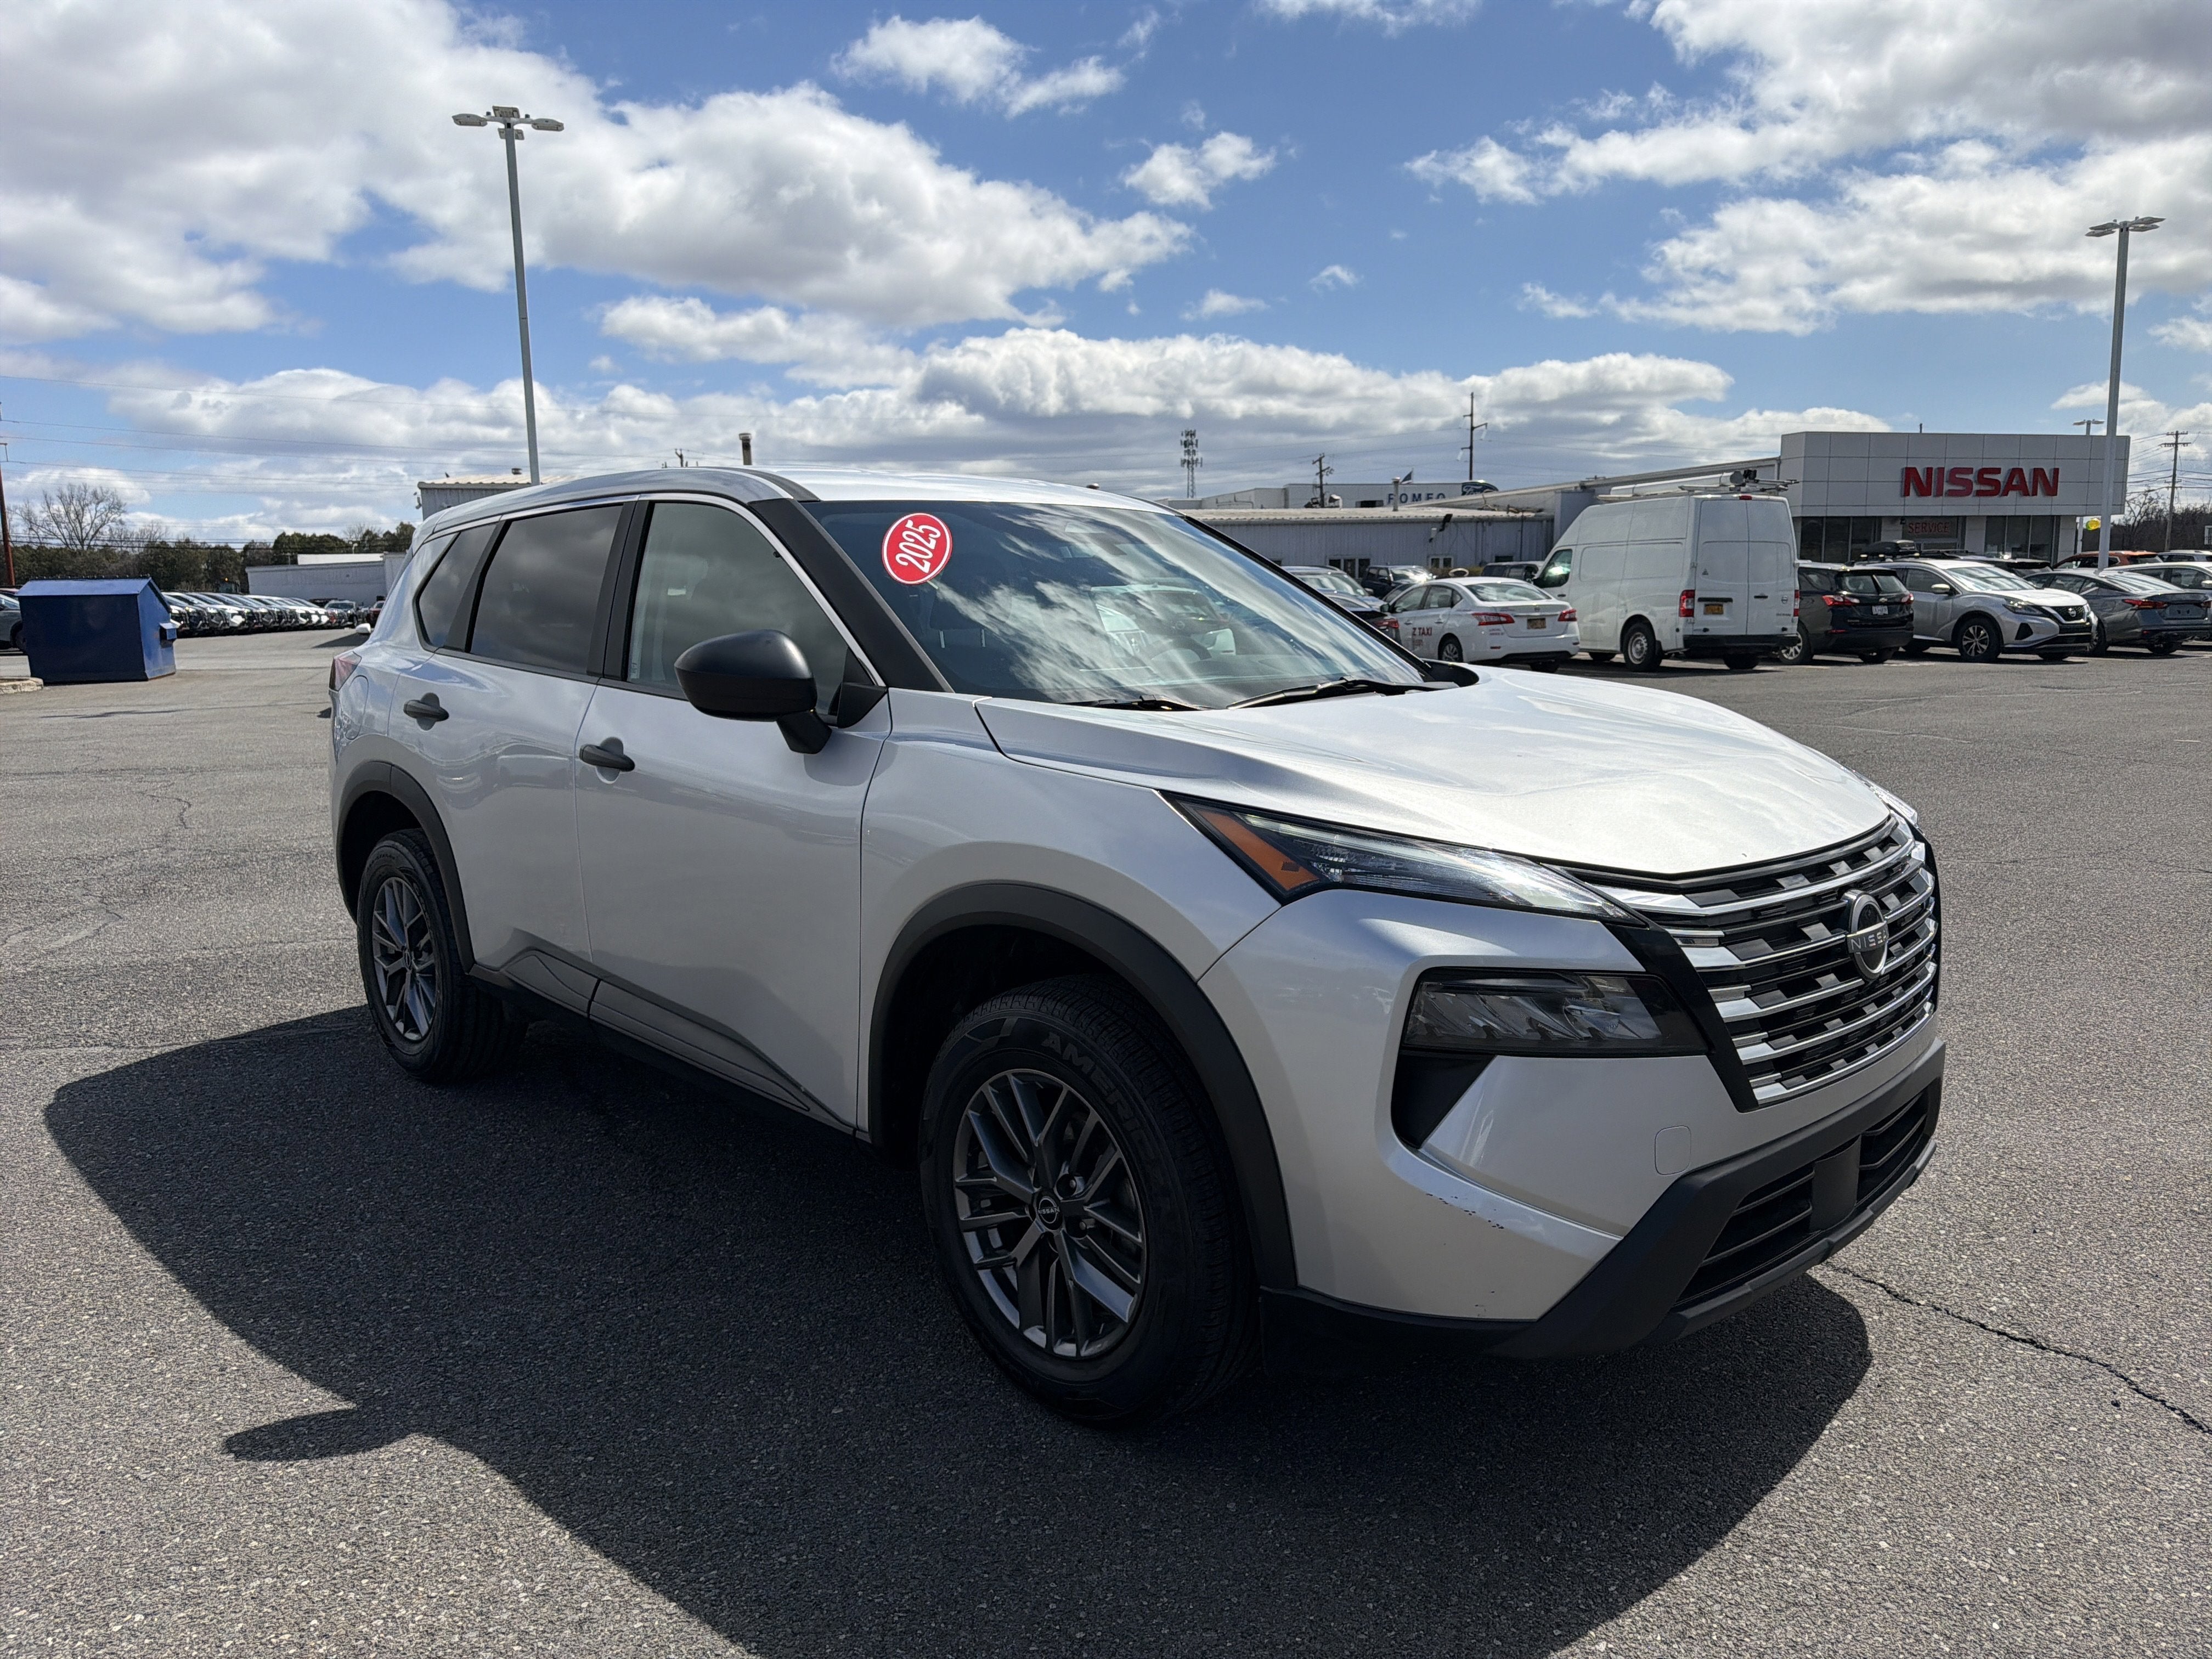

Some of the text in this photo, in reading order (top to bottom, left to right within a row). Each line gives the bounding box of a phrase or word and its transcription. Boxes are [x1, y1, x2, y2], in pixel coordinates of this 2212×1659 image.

[1903, 466, 2059, 497] NISSAN
[1908, 522, 1950, 533] SERVICE
[895, 520, 941, 573] 2025
[1418, 627, 1432, 636] TAXI
